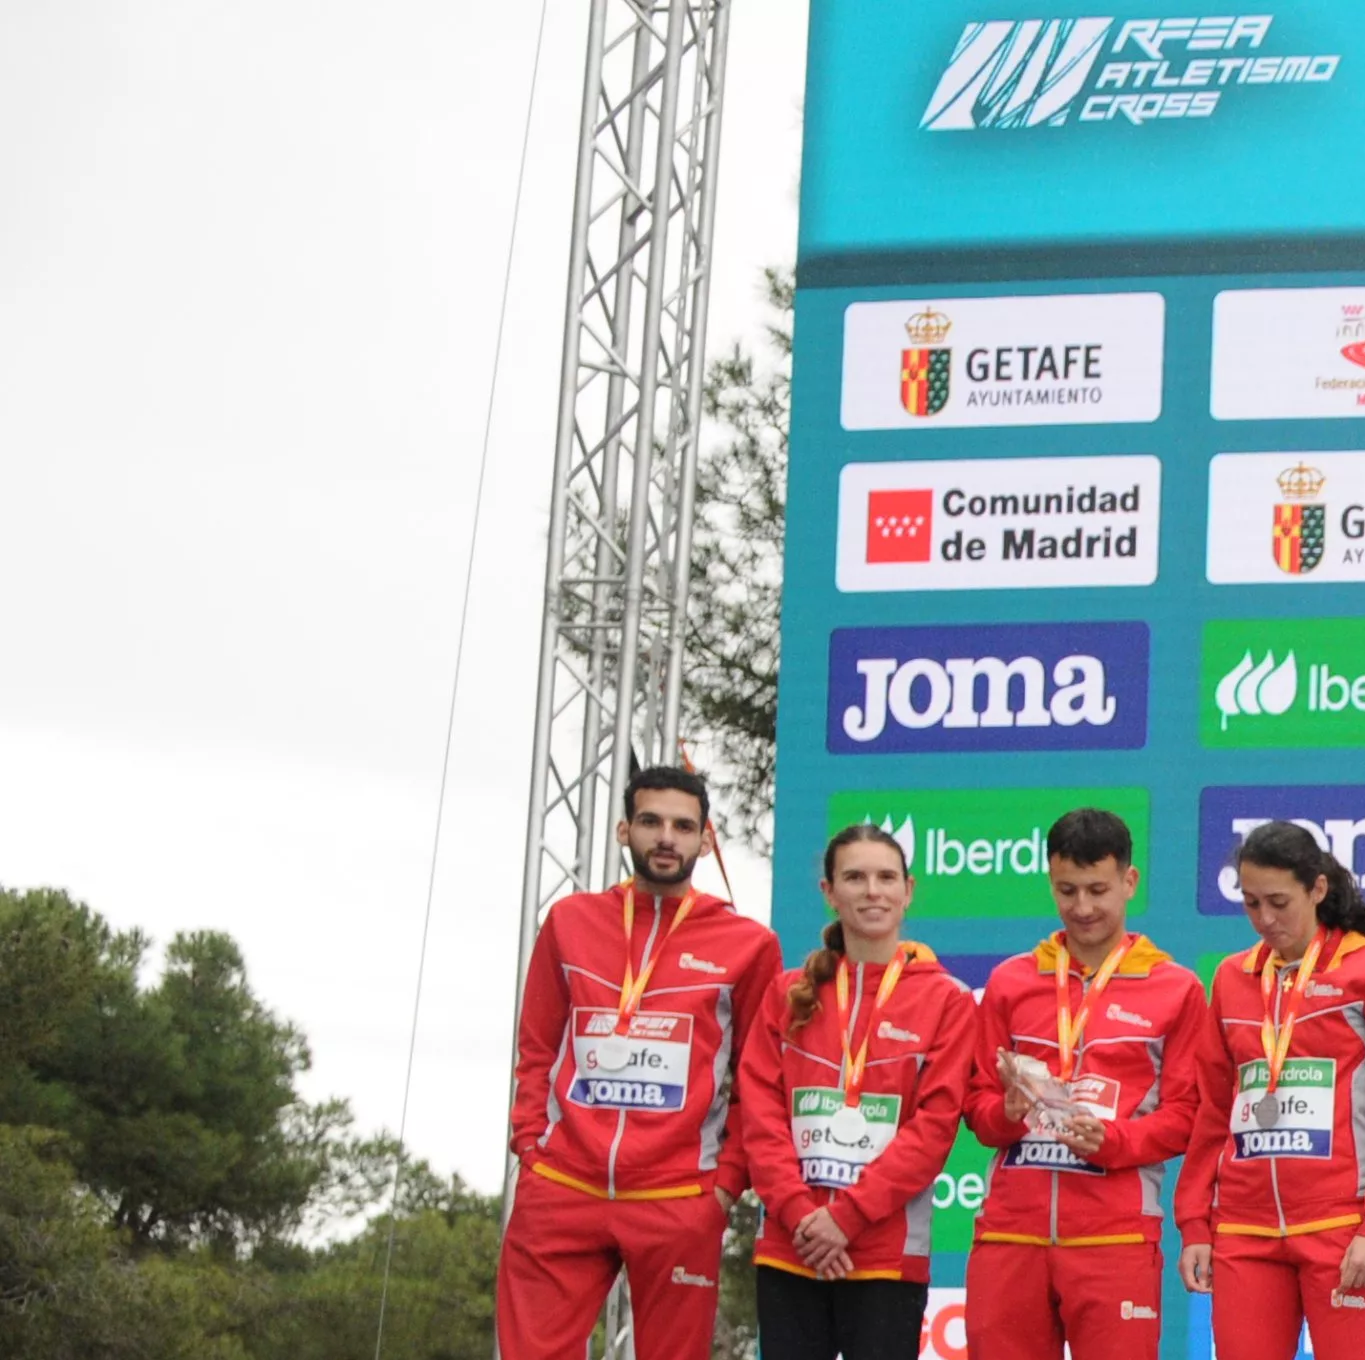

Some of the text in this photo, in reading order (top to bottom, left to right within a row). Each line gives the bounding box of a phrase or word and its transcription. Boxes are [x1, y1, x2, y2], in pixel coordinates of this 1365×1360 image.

[1111, 14, 1273, 53] RFEA
[1093, 55, 1341, 88] ATLETISMO
[1078, 91, 1221, 125] CROSS
[966, 345, 1103, 383] GETAFE
[966, 387, 1103, 407] AYUNTAMIENTO
[942, 486, 1141, 517] Comunidad
[941, 525, 1138, 562] de Madrid
[843, 653, 1116, 742] Joma
[925, 829, 1050, 876] Iberd
[1258, 1066, 1323, 1082] Ibrdrola
[587, 1080, 666, 1105] Joma
[1242, 1130, 1314, 1156] Joma
